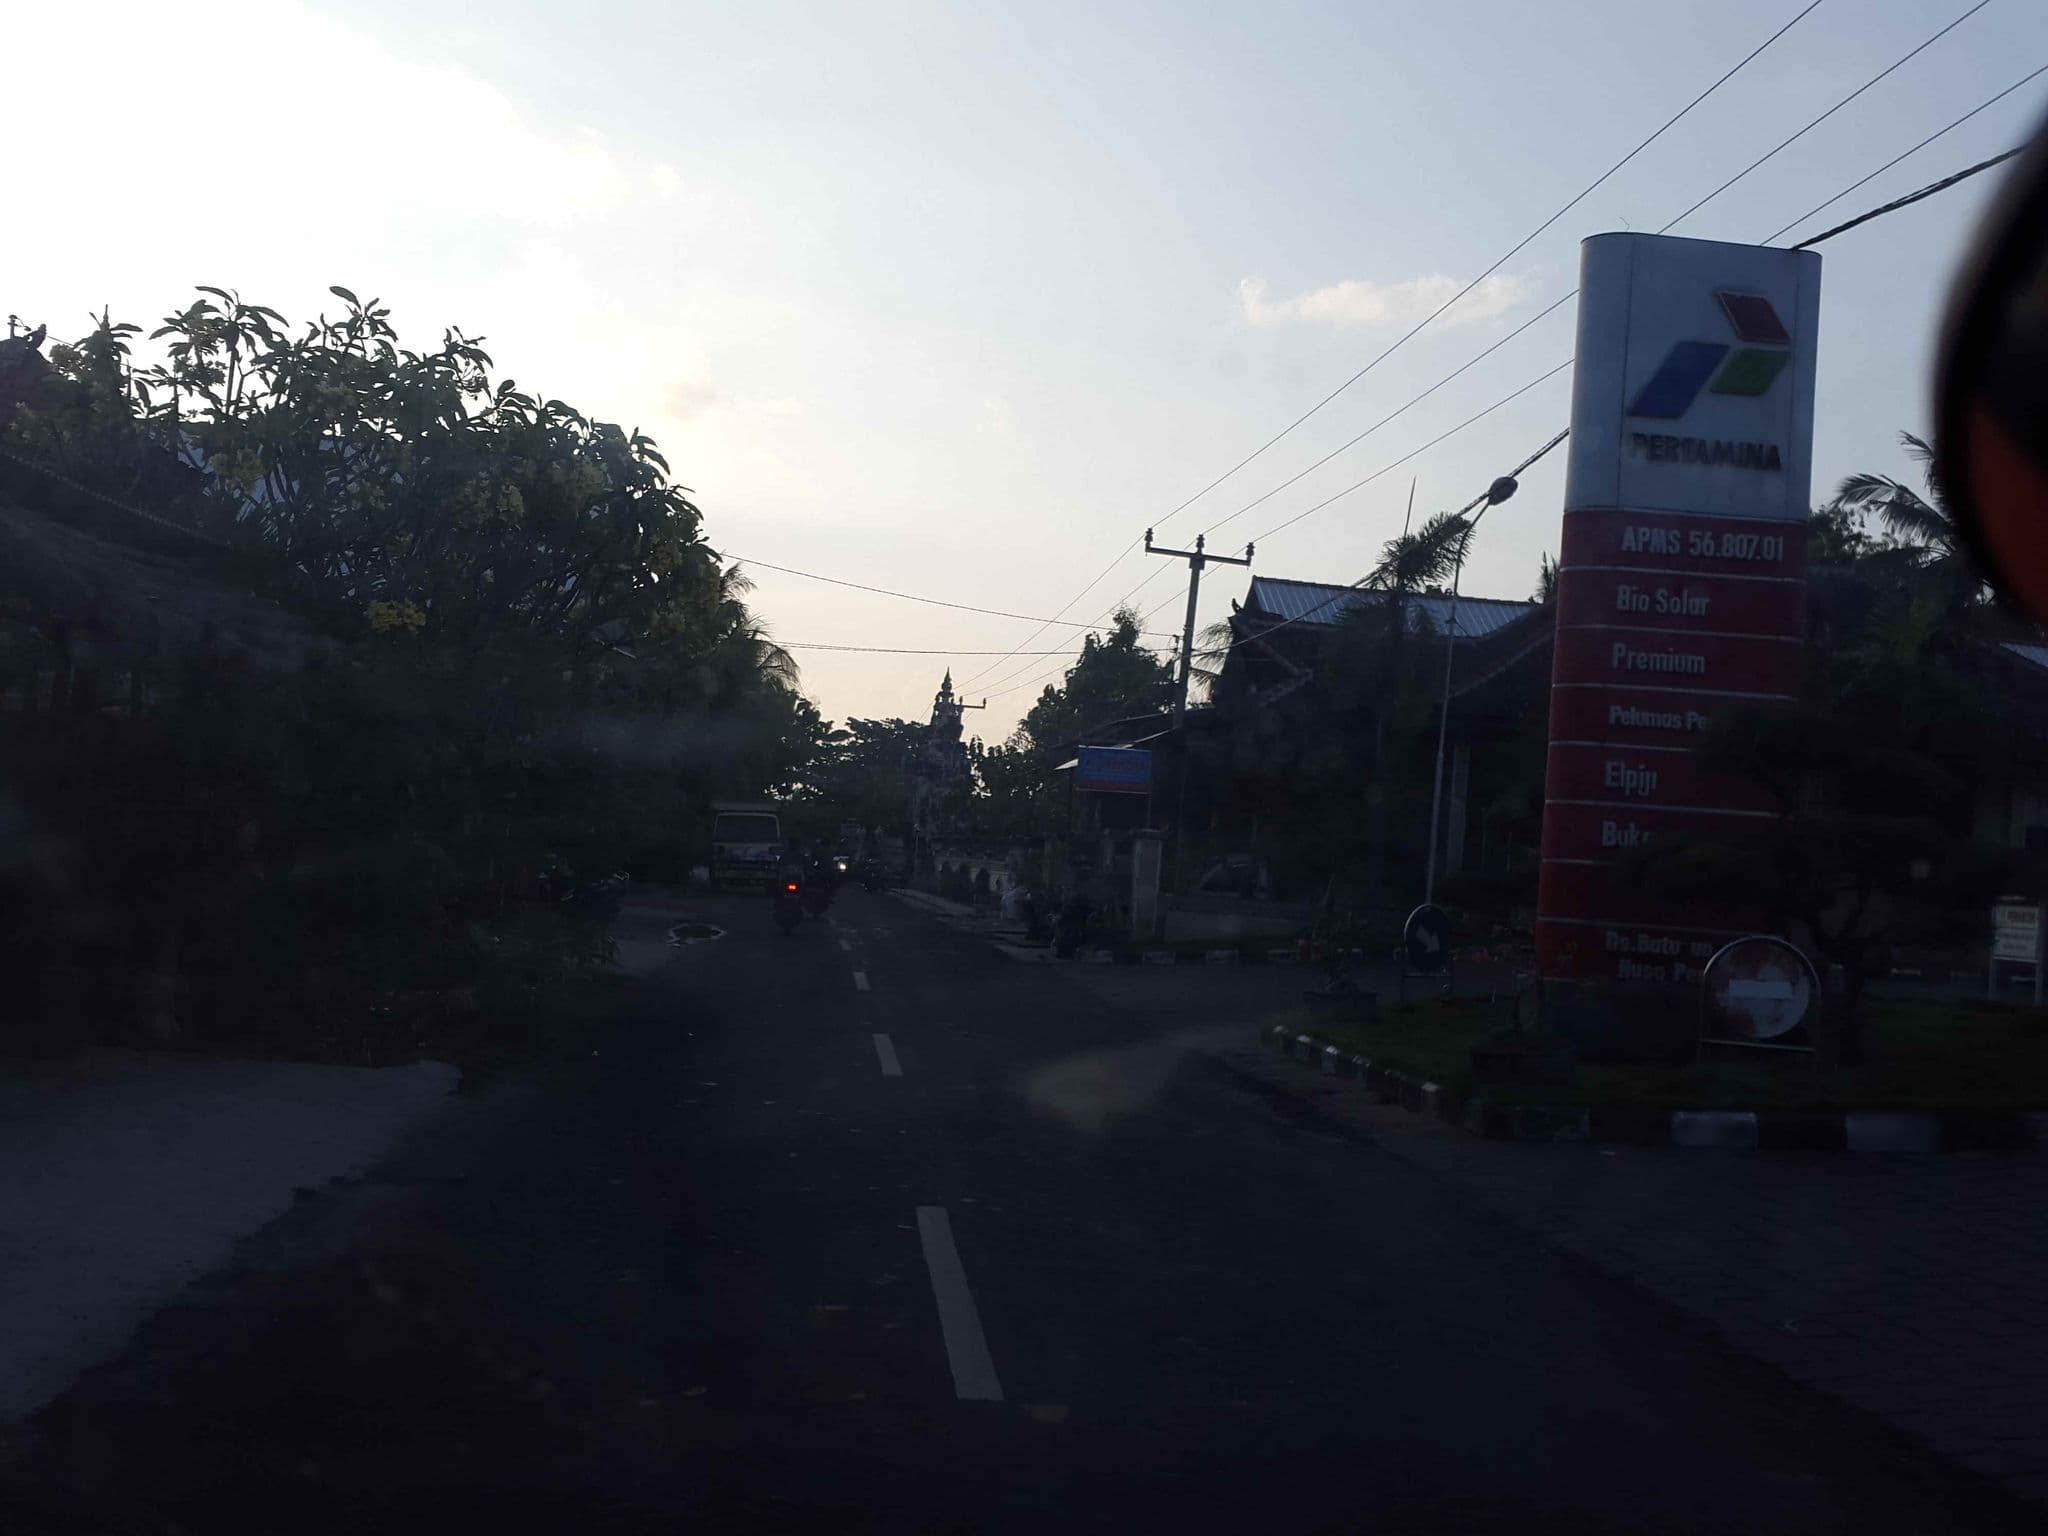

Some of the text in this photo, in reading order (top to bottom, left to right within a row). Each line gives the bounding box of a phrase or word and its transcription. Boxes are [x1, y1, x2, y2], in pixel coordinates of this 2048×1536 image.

[1632, 432, 1783, 472] PERTAMINA
[1622, 525, 1784, 561] APMS 56.807.01
[1616, 584, 1710, 617] Bio Solar
[1612, 642, 1706, 674] Premium
[1608, 704, 1682, 729] Pelumas
